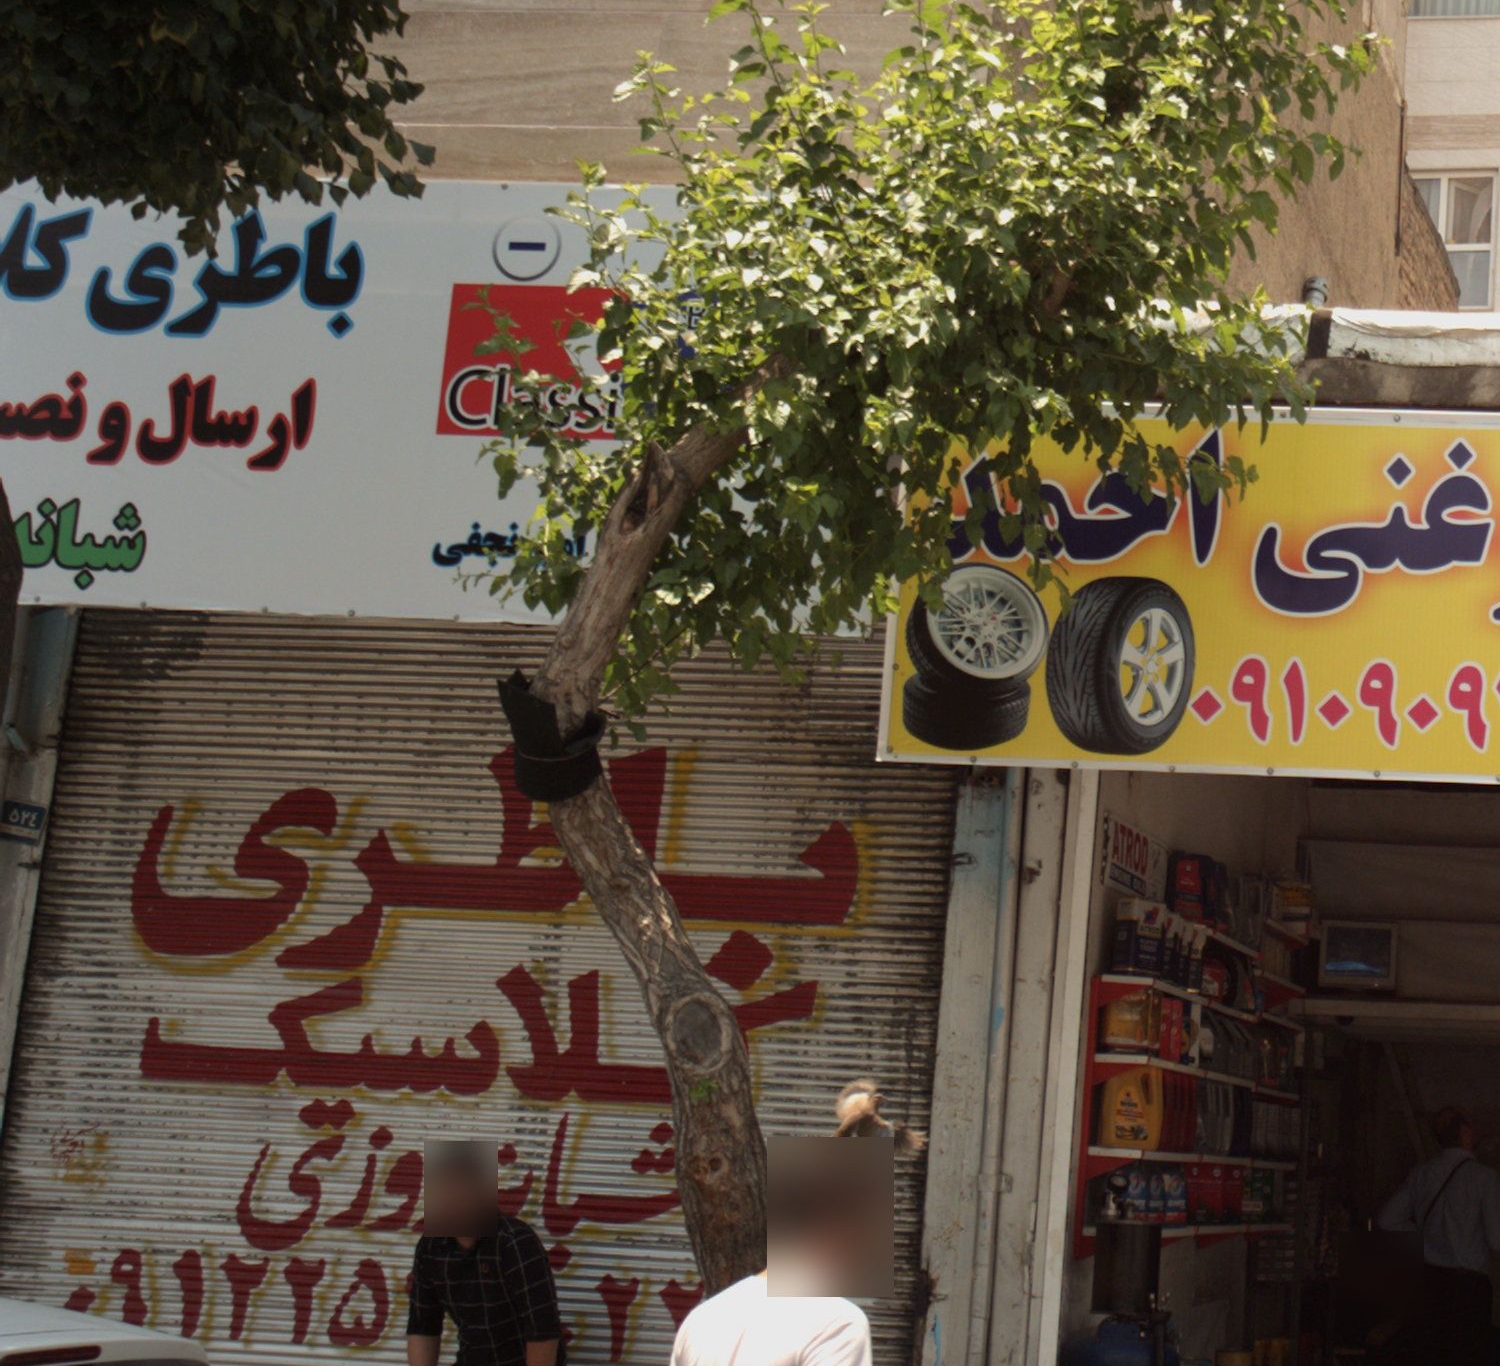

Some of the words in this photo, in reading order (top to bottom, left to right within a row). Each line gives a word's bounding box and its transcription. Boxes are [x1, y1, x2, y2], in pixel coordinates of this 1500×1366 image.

[86, 211, 364, 339] باطری
[86, 400, 131, 466] و
[136, 372, 317, 472] ارسال
